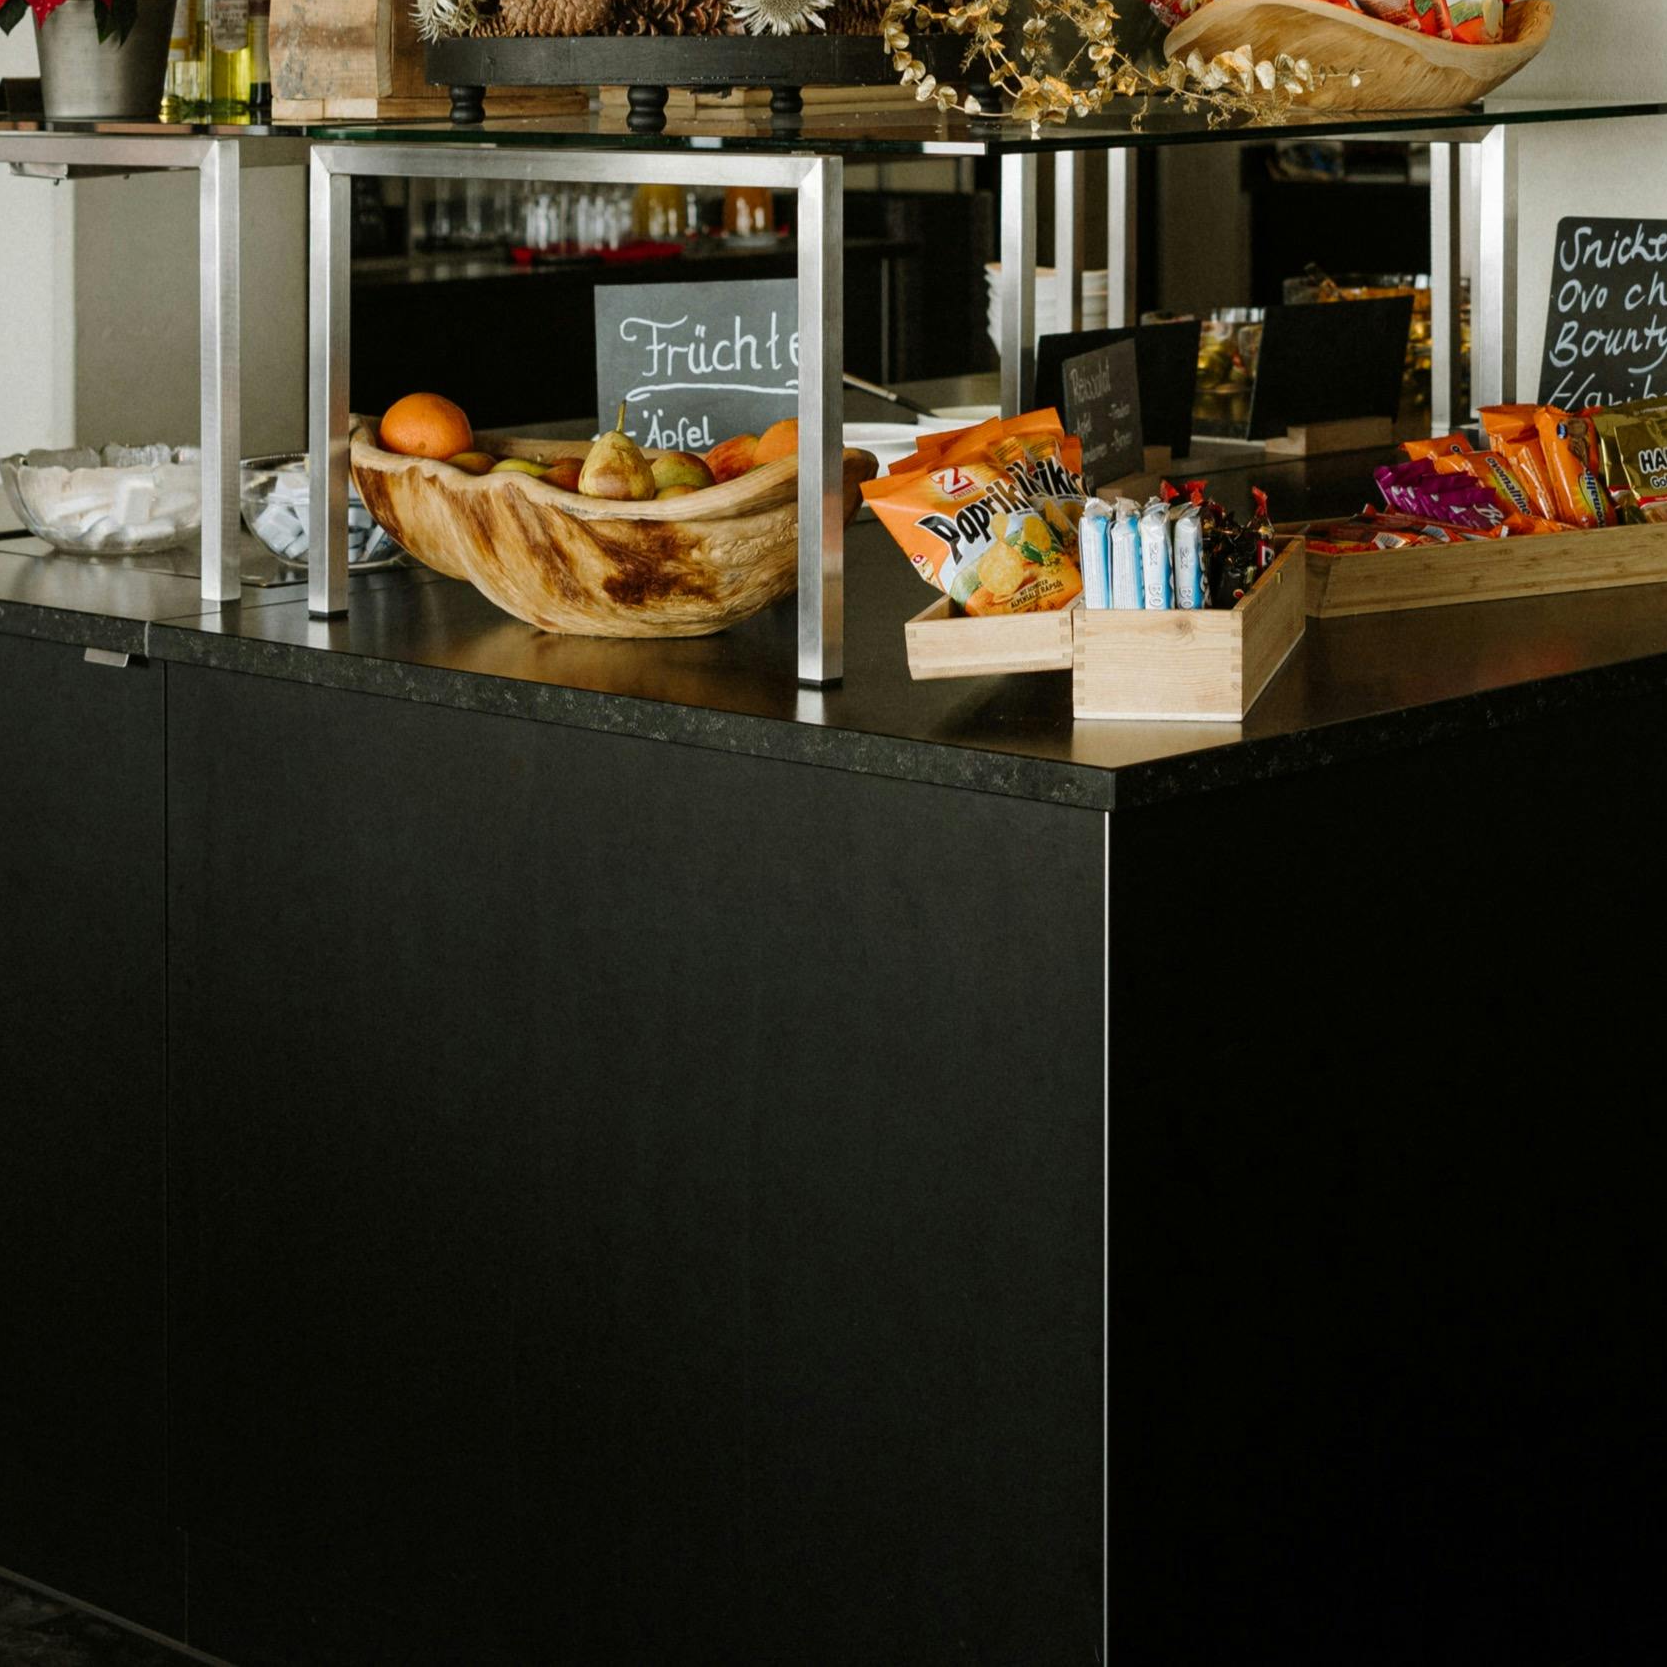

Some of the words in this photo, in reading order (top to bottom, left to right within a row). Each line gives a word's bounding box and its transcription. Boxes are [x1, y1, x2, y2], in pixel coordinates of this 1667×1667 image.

[1557, 279, 1608, 313] Ovo
[642, 409, 716, 451] Äpfel
[1485, 456, 1532, 517] ovomaltine
